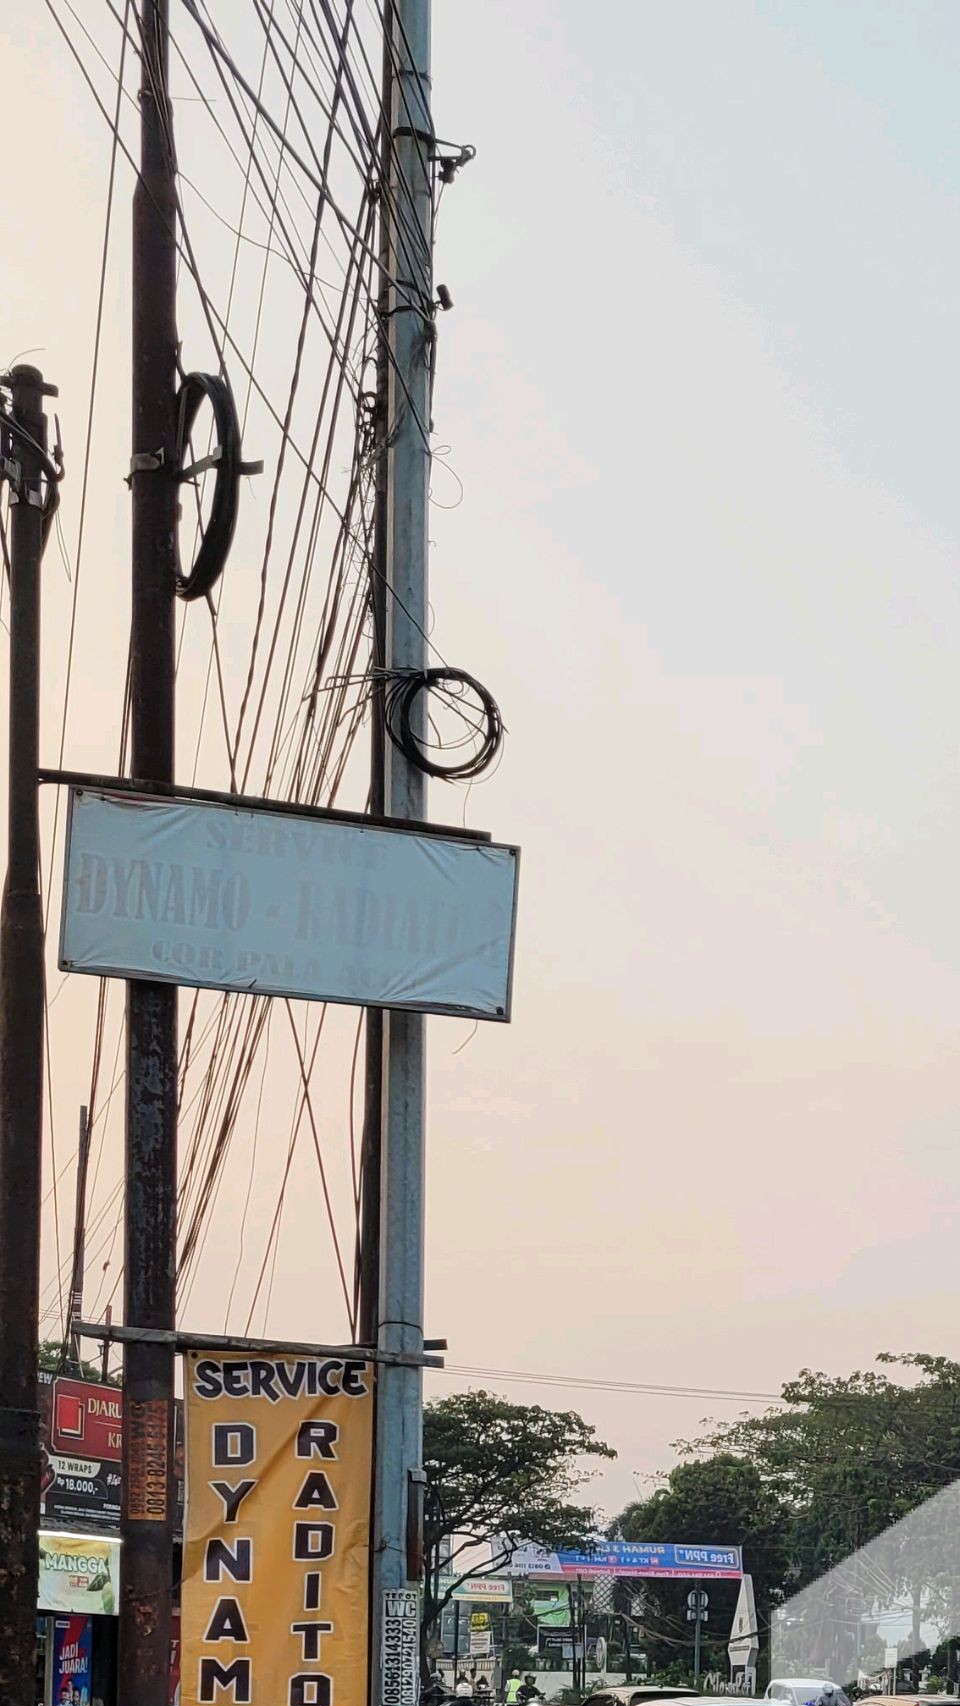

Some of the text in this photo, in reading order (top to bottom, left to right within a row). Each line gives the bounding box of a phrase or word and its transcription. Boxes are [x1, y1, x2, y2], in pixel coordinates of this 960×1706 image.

[75, 852, 252, 932] DYNAMO
[37, 1373, 53, 1385] EW
[194, 1359, 369, 1404] SERVICE
[87, 1398, 122, 1419] DJARU
[58, 1460, 92, 1474] 12 WRAPS
[57, 1478, 65, 1486] Rp
[147, 1481, 165, 1515] 0813
[45, 1552, 107, 1574] MANGGA
[386, 1600, 416, 1617] WC
[59, 1642, 79, 1660] JADI
[58, 1657, 88, 1674] JUARA!
